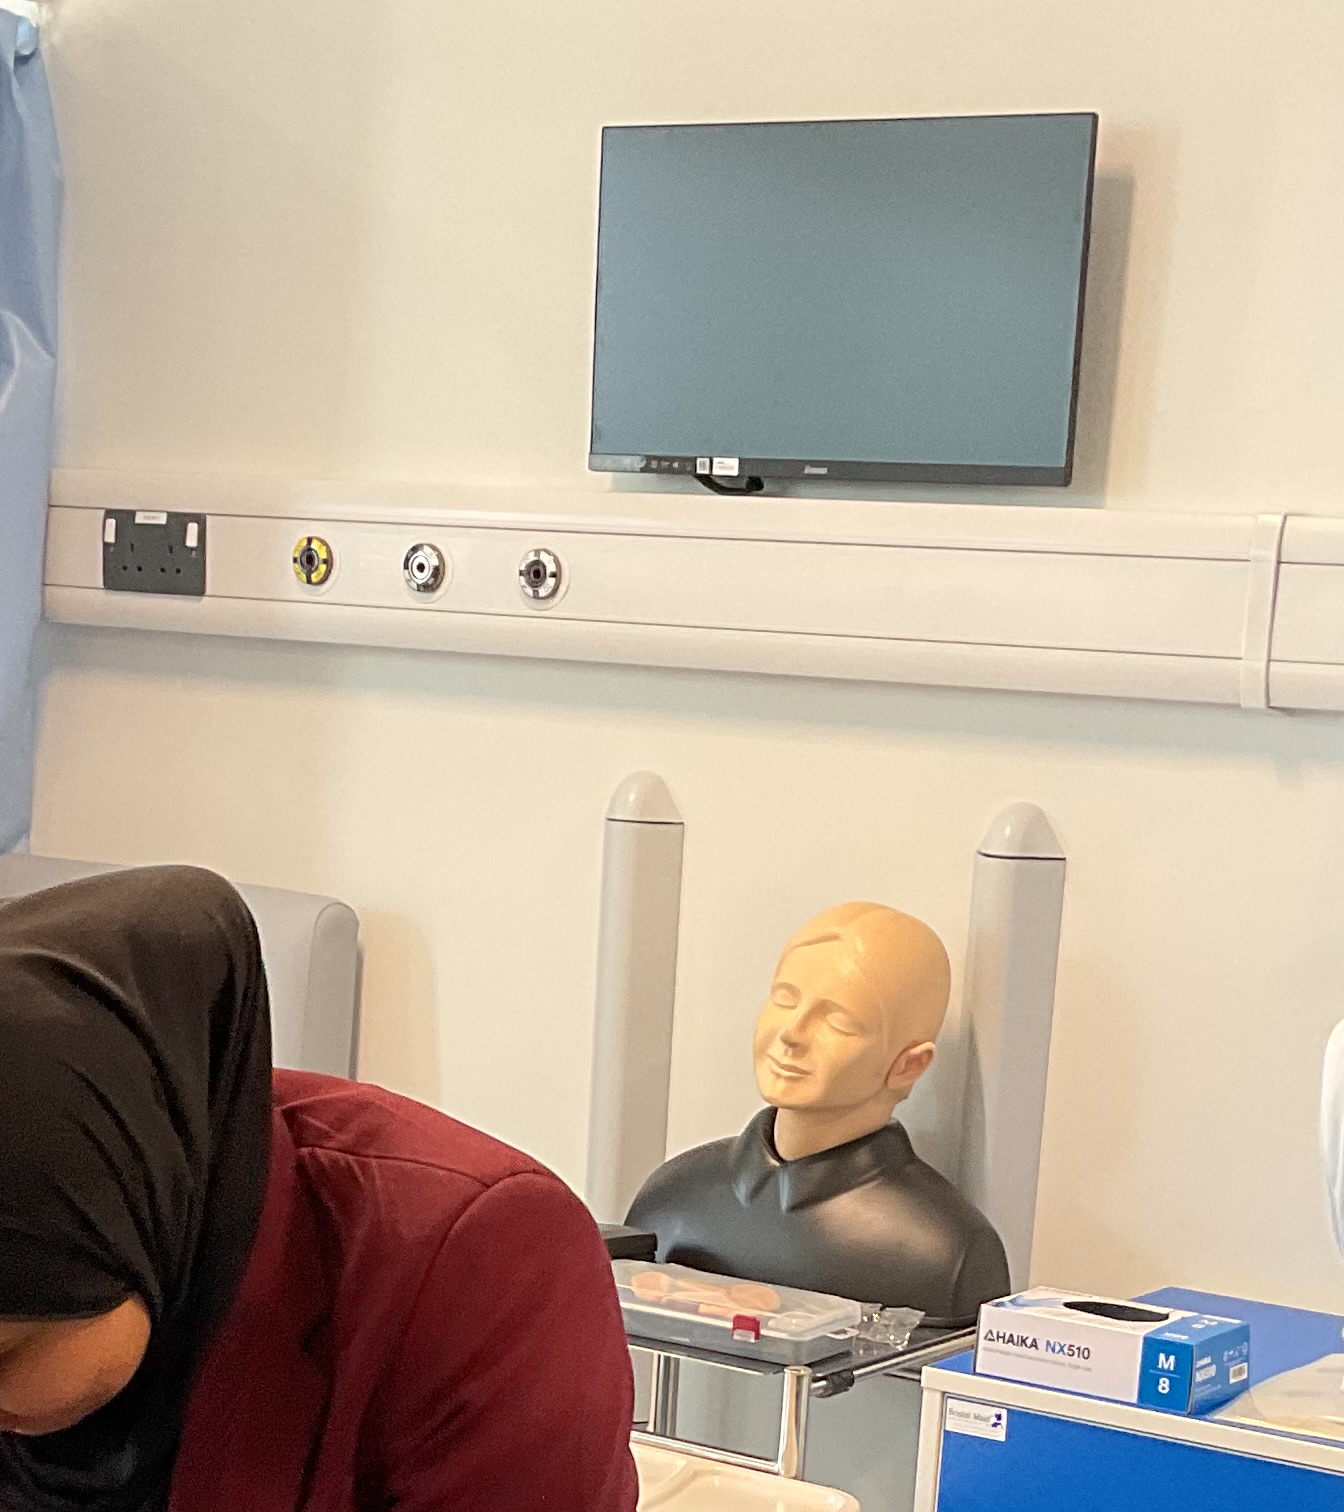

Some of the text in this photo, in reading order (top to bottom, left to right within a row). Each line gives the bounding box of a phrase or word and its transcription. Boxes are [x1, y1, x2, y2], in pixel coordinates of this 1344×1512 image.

[996, 1331, 1039, 1350] HAIKA
[1045, 1340, 1091, 1360] NX510
[1158, 1352, 1176, 1371] M
[1157, 1377, 1170, 1394] 8
